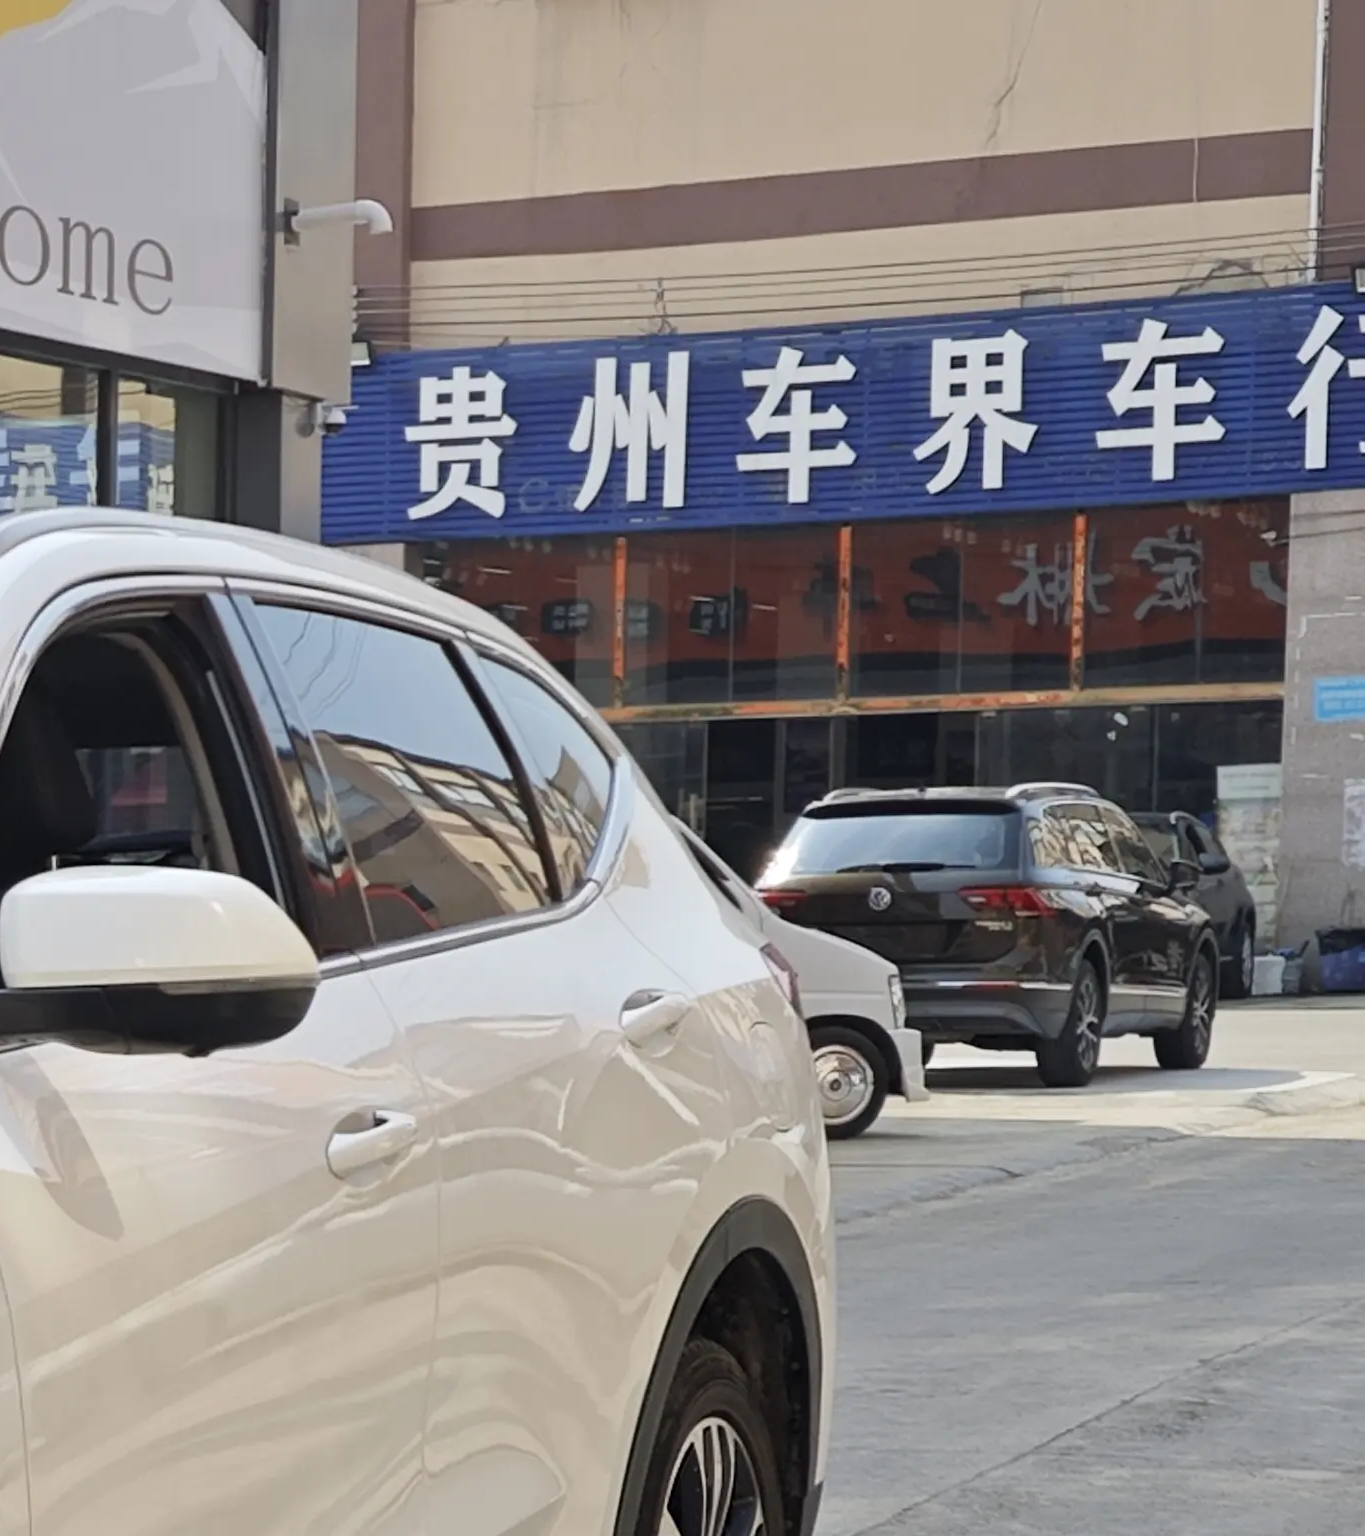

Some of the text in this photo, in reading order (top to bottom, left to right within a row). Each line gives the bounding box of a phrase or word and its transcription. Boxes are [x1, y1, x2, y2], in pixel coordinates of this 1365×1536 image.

[405, 305, 1365, 519] 贵州车界车行
